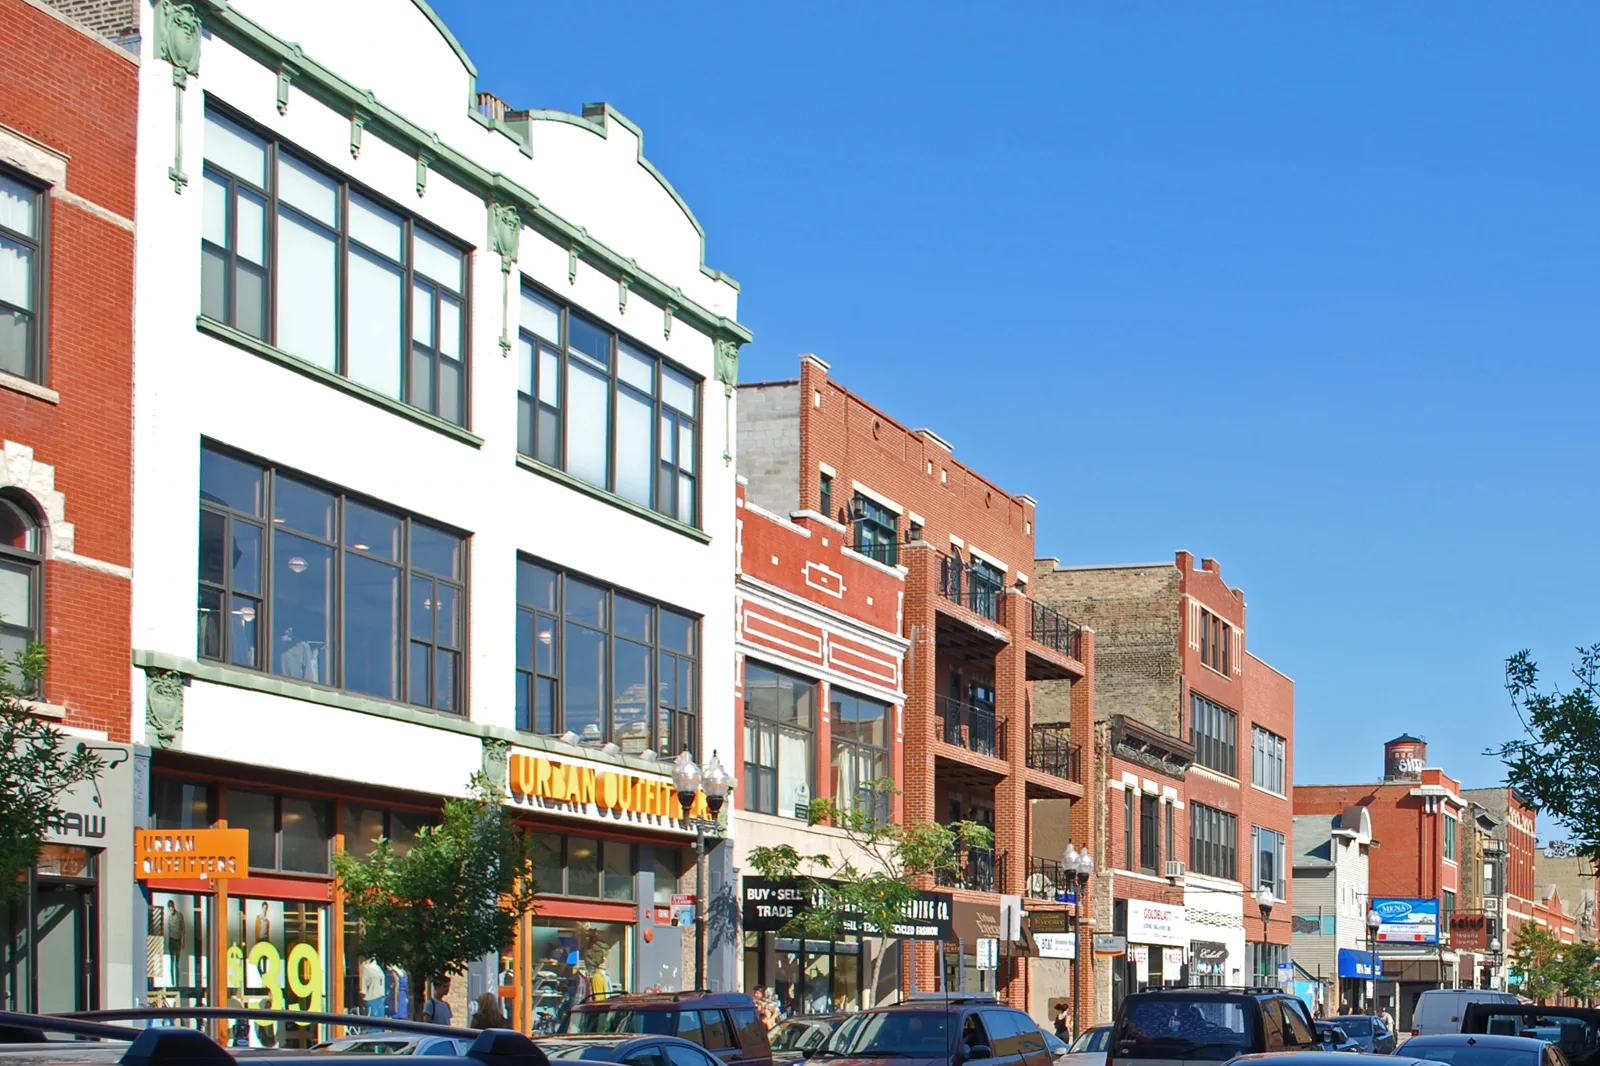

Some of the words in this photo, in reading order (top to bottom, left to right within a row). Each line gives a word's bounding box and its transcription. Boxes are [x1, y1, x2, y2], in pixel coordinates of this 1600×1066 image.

[510, 753, 595, 804] URBAN
[596, 771, 720, 822] OUTFITR
[44, 812, 107, 838] RAW
[143, 835, 195, 852] URBAN
[143, 855, 237, 874] OUTFITTERS
[746, 888, 770, 900] BUY
[777, 888, 803, 900] SELL
[756, 905, 793, 917] TRADE
[895, 899, 935, 919] ADING
[937, 901, 949, 920] CO.
[1143, 907, 1171, 921] GOLDBLATT
[1449, 915, 1483, 930] salud
[916, 926, 938, 936] FASHION
